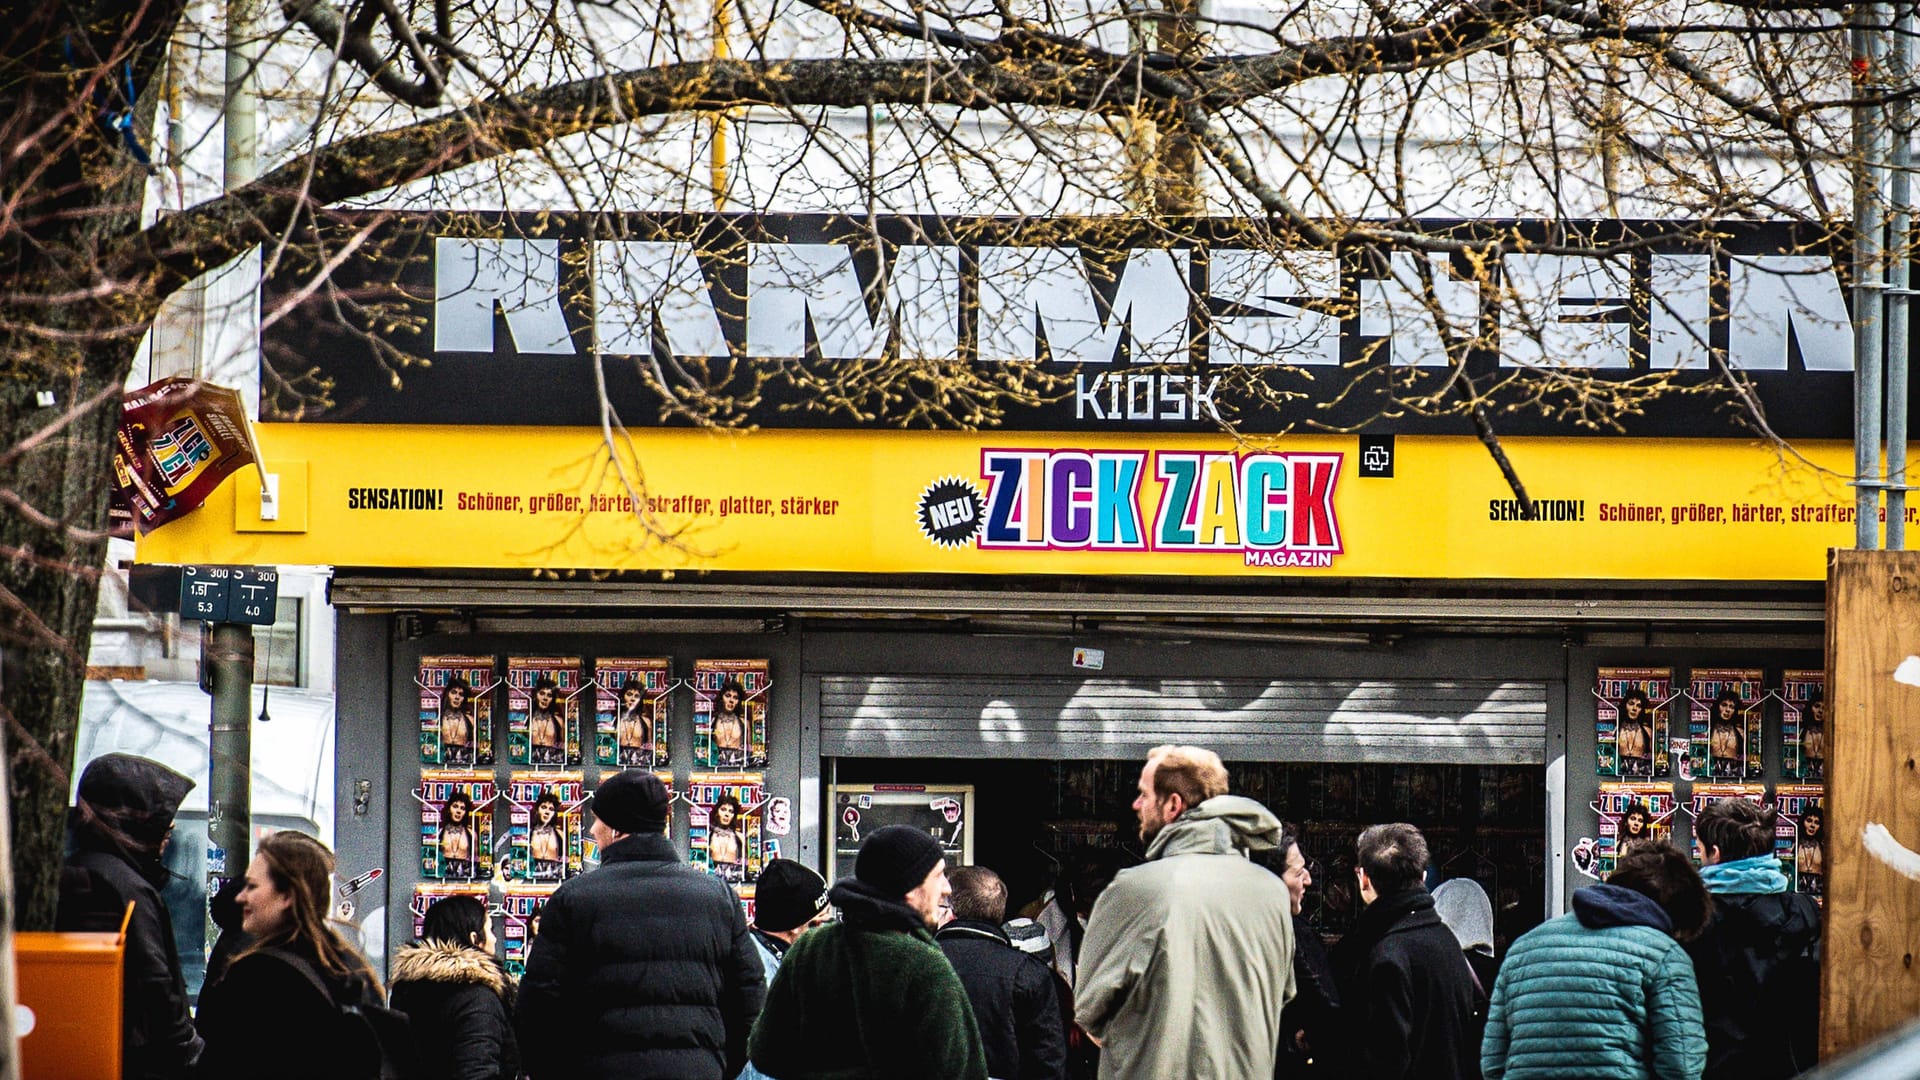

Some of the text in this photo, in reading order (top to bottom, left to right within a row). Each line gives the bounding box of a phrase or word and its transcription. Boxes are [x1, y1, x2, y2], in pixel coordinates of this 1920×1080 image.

[434, 237, 1855, 371] RAMMSTEIN
[1076, 373, 1221, 421] KIOSK
[149, 432, 194, 487] ZACK
[171, 416, 213, 467] ZICK
[348, 487, 839, 517] SENSATION! Schöner, größer, härter, straffer, glatter, stärker
[929, 495, 975, 531] NEU
[983, 453, 1336, 549] ZICK ZACK
[1599, 502, 1665, 524] Schöner,
[1671, 503, 1726, 525] größer,
[1732, 503, 1786, 525] härter,
[1791, 503, 1857, 525] straffer,
[210, 568, 229, 579] 300
[257, 571, 276, 582] 300
[1246, 552, 1332, 567] MAGAZIN
